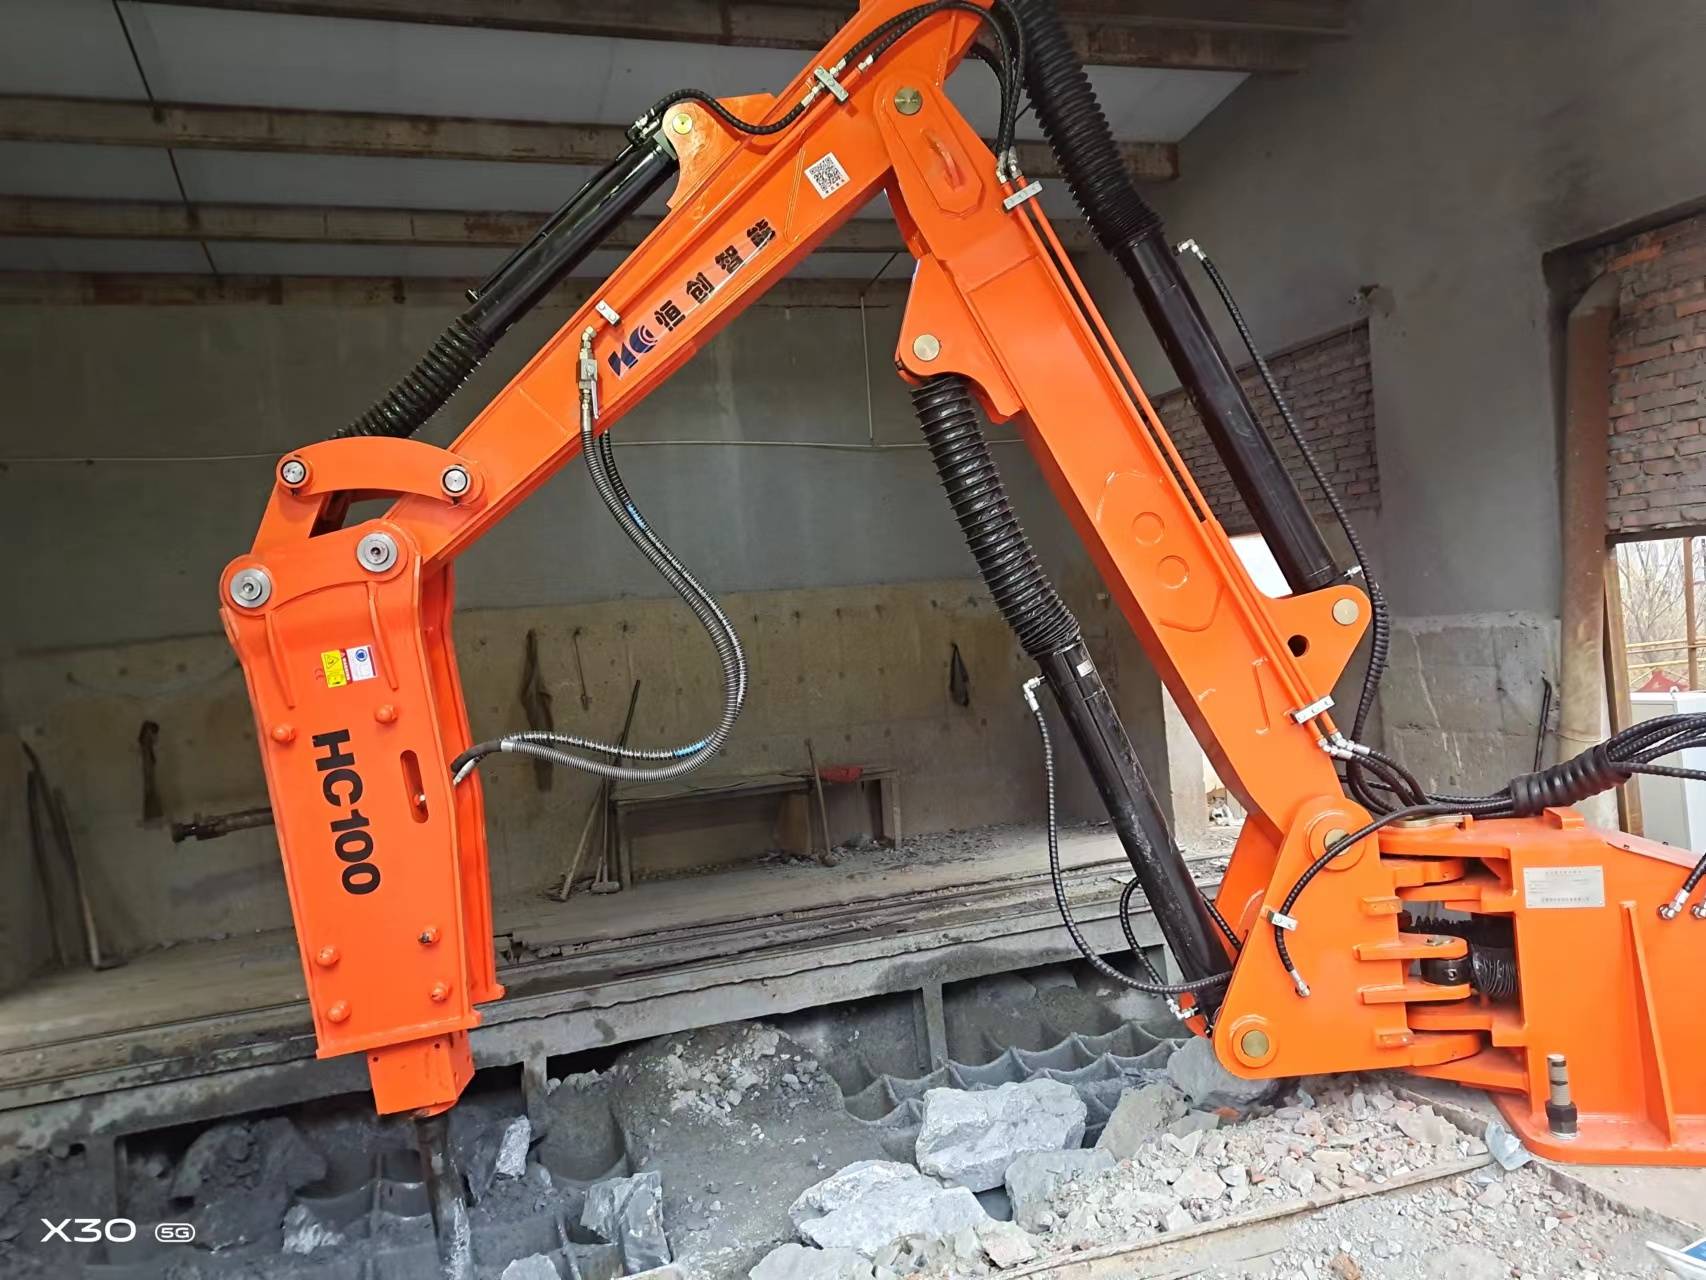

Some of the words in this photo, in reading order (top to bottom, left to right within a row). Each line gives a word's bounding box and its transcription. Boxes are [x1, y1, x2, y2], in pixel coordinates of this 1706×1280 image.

[654, 218, 776, 332] 恒创智能
[312, 729, 381, 895] HC100
